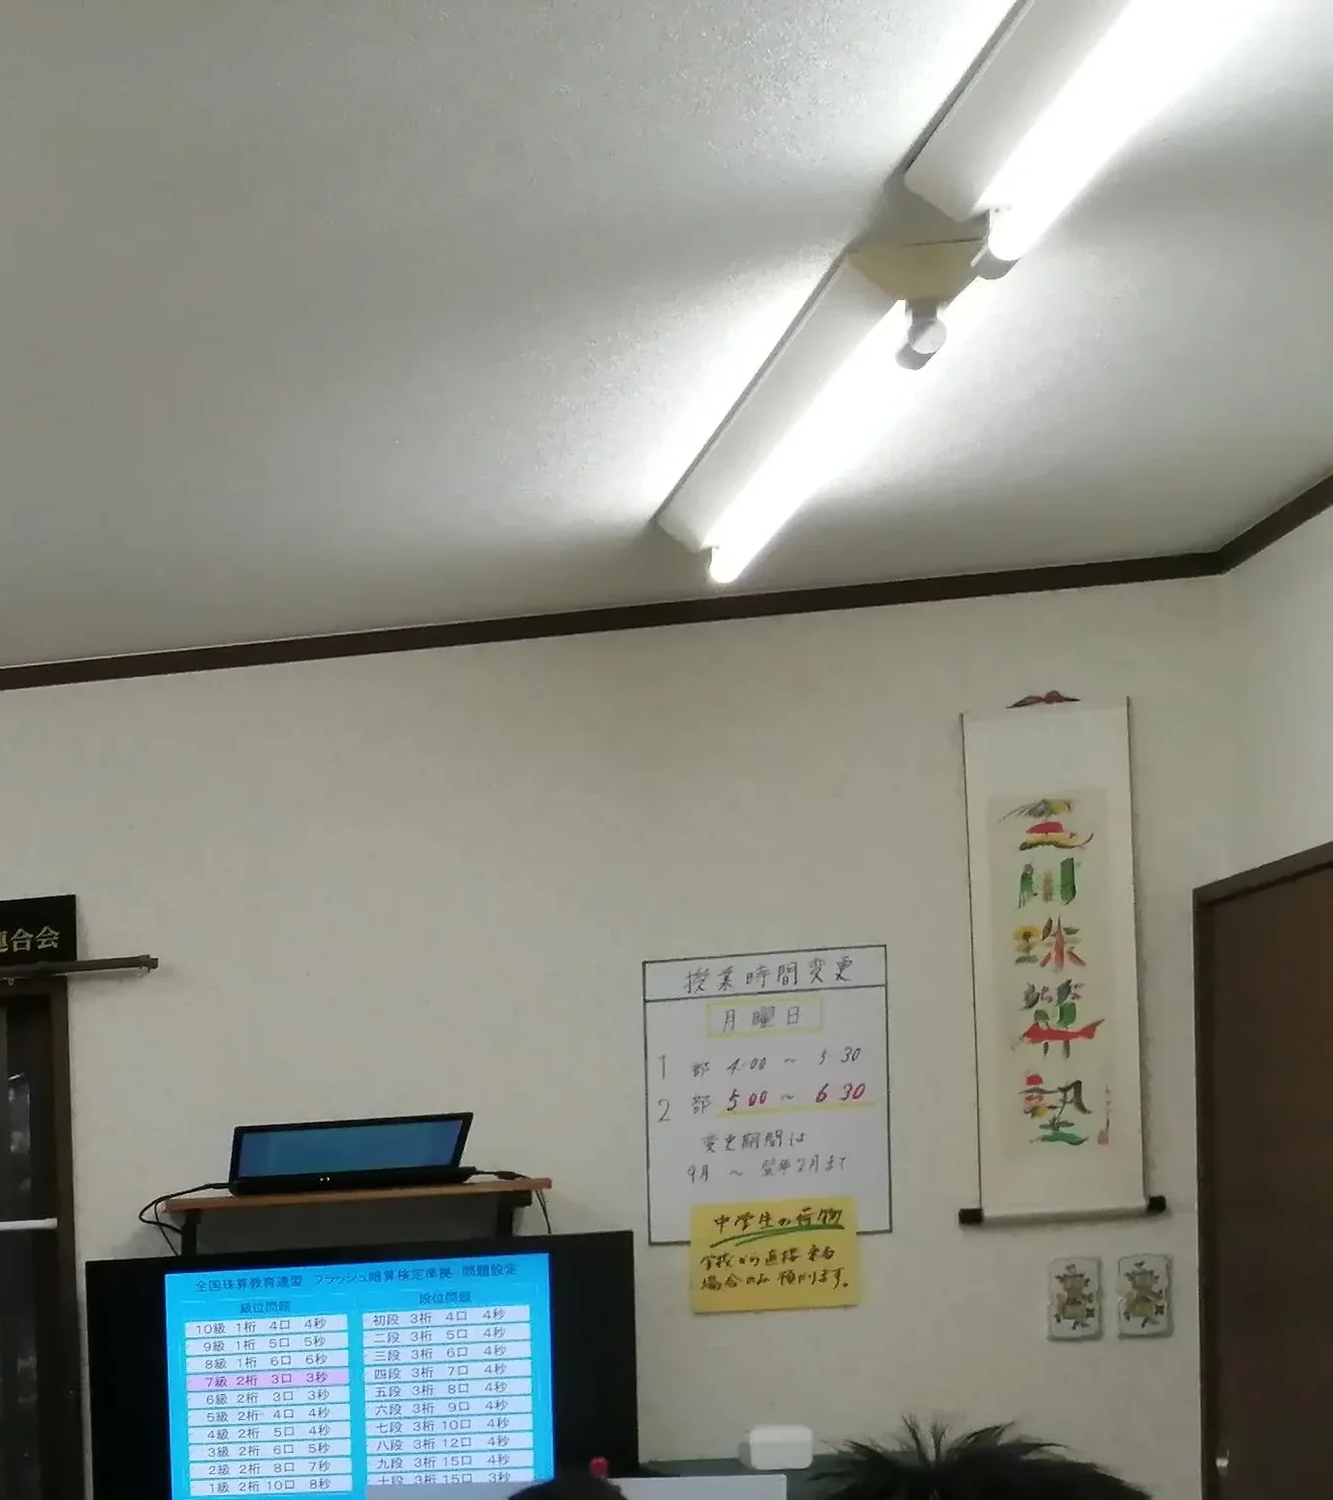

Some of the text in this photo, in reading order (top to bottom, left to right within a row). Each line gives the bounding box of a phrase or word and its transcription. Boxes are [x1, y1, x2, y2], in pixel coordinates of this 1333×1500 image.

[683, 955, 854, 995] 授業時間変更
[722, 1005, 800, 1033] 月曜日
[713, 1206, 844, 1234] 中学生の荷物
[196, 1275, 303, 1292] 全国珠算教育連盟
[462, 1263, 518, 1277] 問題設定
[196, 1317, 327, 1335] 10級 1桁 4口 4秒
[373, 1308, 506, 1327] 初段 3桁 4口 4秒
[373, 1326, 506, 1344] 二段 3桁 5口 4秒
[203, 1336, 326, 1352] 9級 1桁 5口 5秒
[204, 1353, 328, 1370] 8級 1桁 6口 6秒
[374, 1345, 507, 1362] 三段 3桁 6口 4秒
[205, 1371, 328, 1388] 7級 2桁 3口 3秒
[374, 1362, 507, 1380] 四段 3桁 7口 4秒
[206, 1389, 329, 1405] 6級 2桁 3口 3秒
[375, 1381, 508, 1397] 五段 3桁 8口 4秒
[207, 1406, 330, 1423] 5級 2桁 4口 4秒
[375, 1399, 508, 1416] 六段 3桁 9口 4秒
[207, 1424, 331, 1440] 4級 2桁 5口 4秒
[376, 1417, 509, 1434] 七段 3桁 10口 4秒
[207, 1442, 331, 1458] 3級 2桁 6口 5秒
[208, 1460, 331, 1476] 2級 2桁 8口 7秒
[209, 1478, 331, 1494] 1級 2桁 10口 8秒
